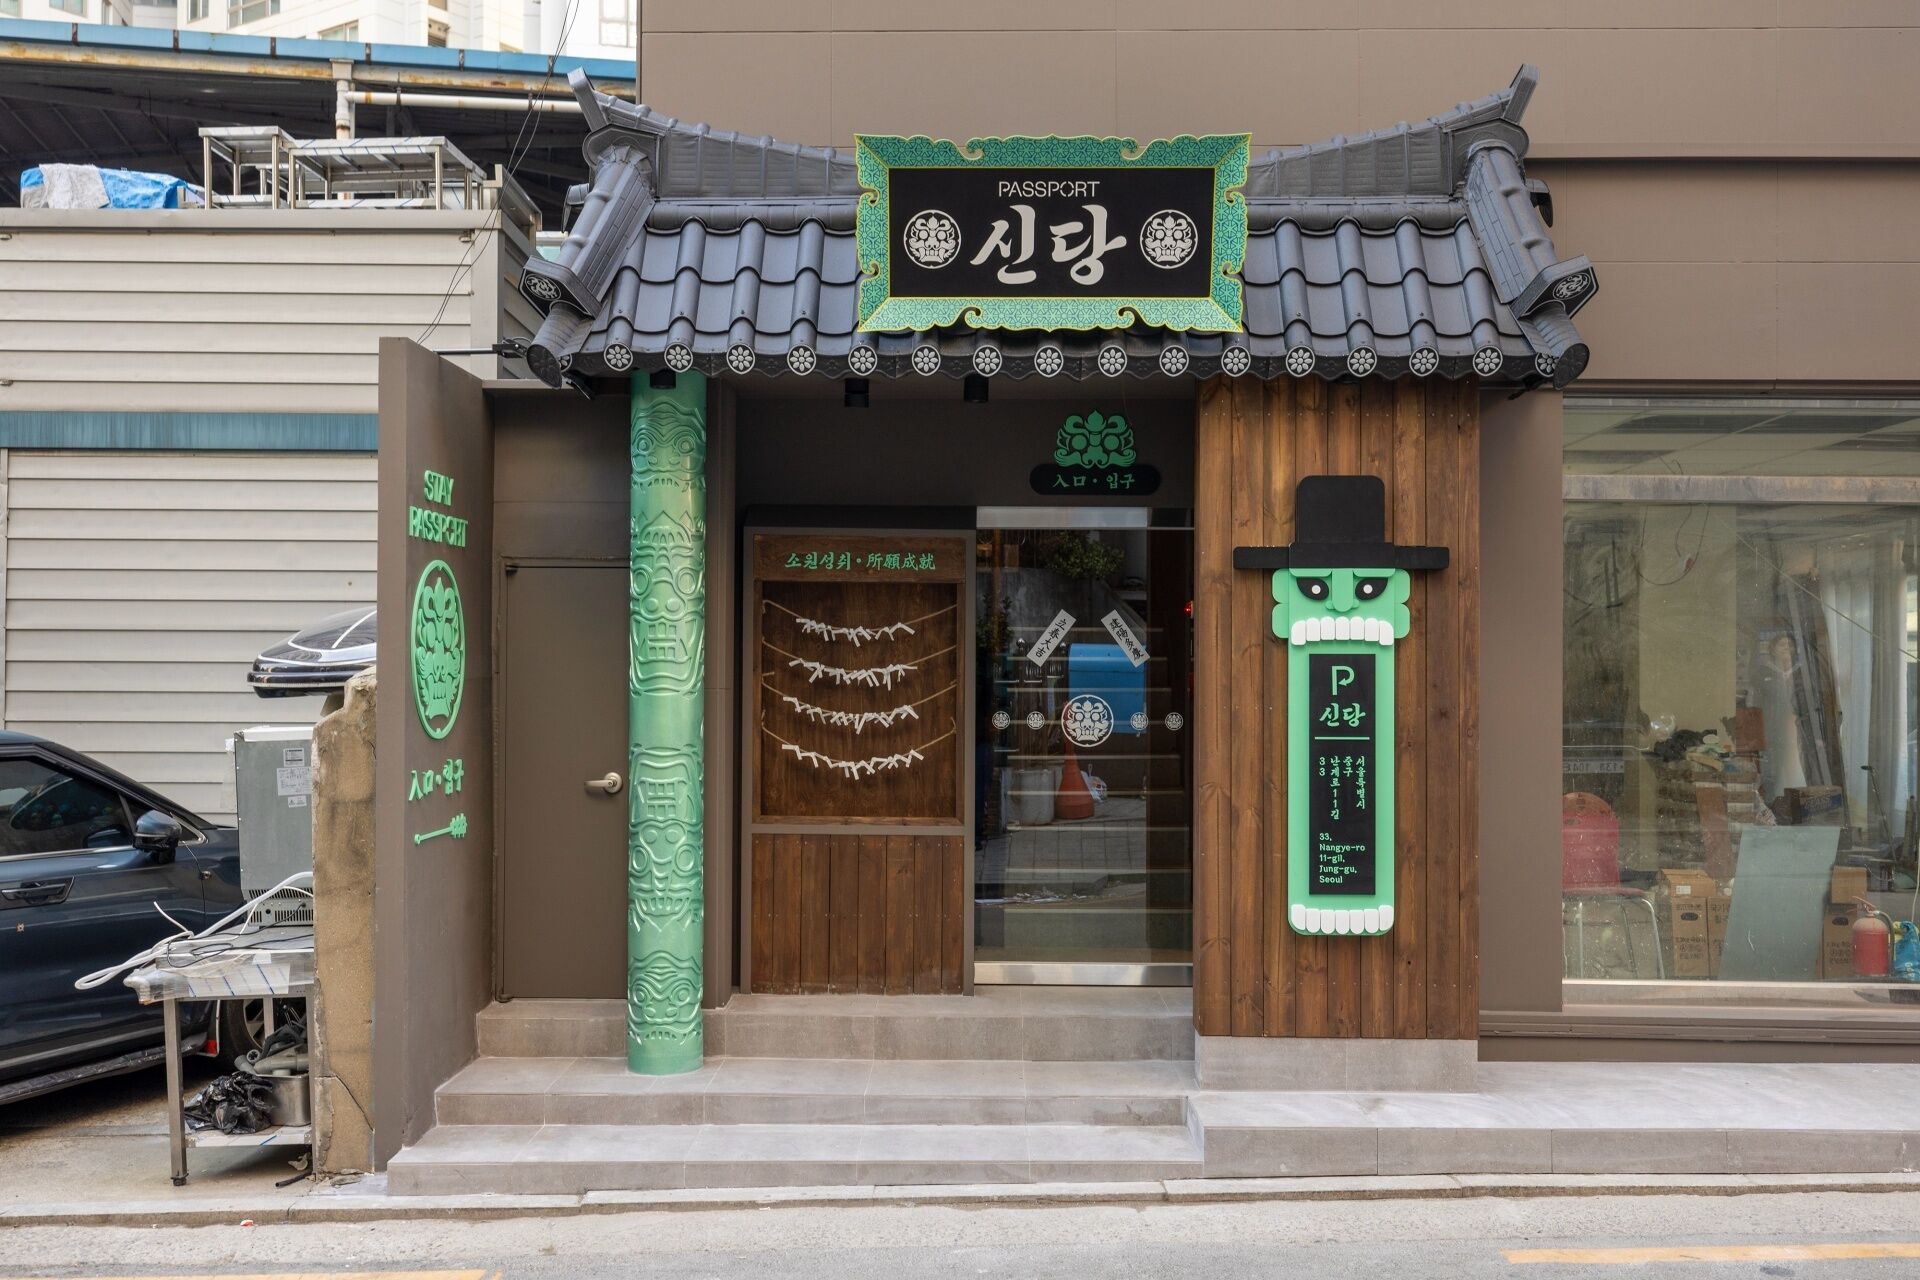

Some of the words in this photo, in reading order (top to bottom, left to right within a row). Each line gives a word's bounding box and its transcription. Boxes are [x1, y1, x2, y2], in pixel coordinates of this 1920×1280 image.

[998, 180, 1100, 198] PASSPORT
[969, 204, 1127, 286] 신당
[424, 470, 454, 506] STAY
[409, 505, 468, 548] PASSPORT
[1319, 702, 1366, 727] 신당
[1342, 755, 1354, 778] 중구
[1355, 755, 1367, 810] 서울특별시
[1319, 832, 1332, 842] 33,
[1319, 843, 1366, 853] Nangye-ro
[1319, 854, 1345, 864] 11-gil,
[1319, 864, 1358, 875] Jung-gu,
[1319, 875, 1343, 884] Seoul
